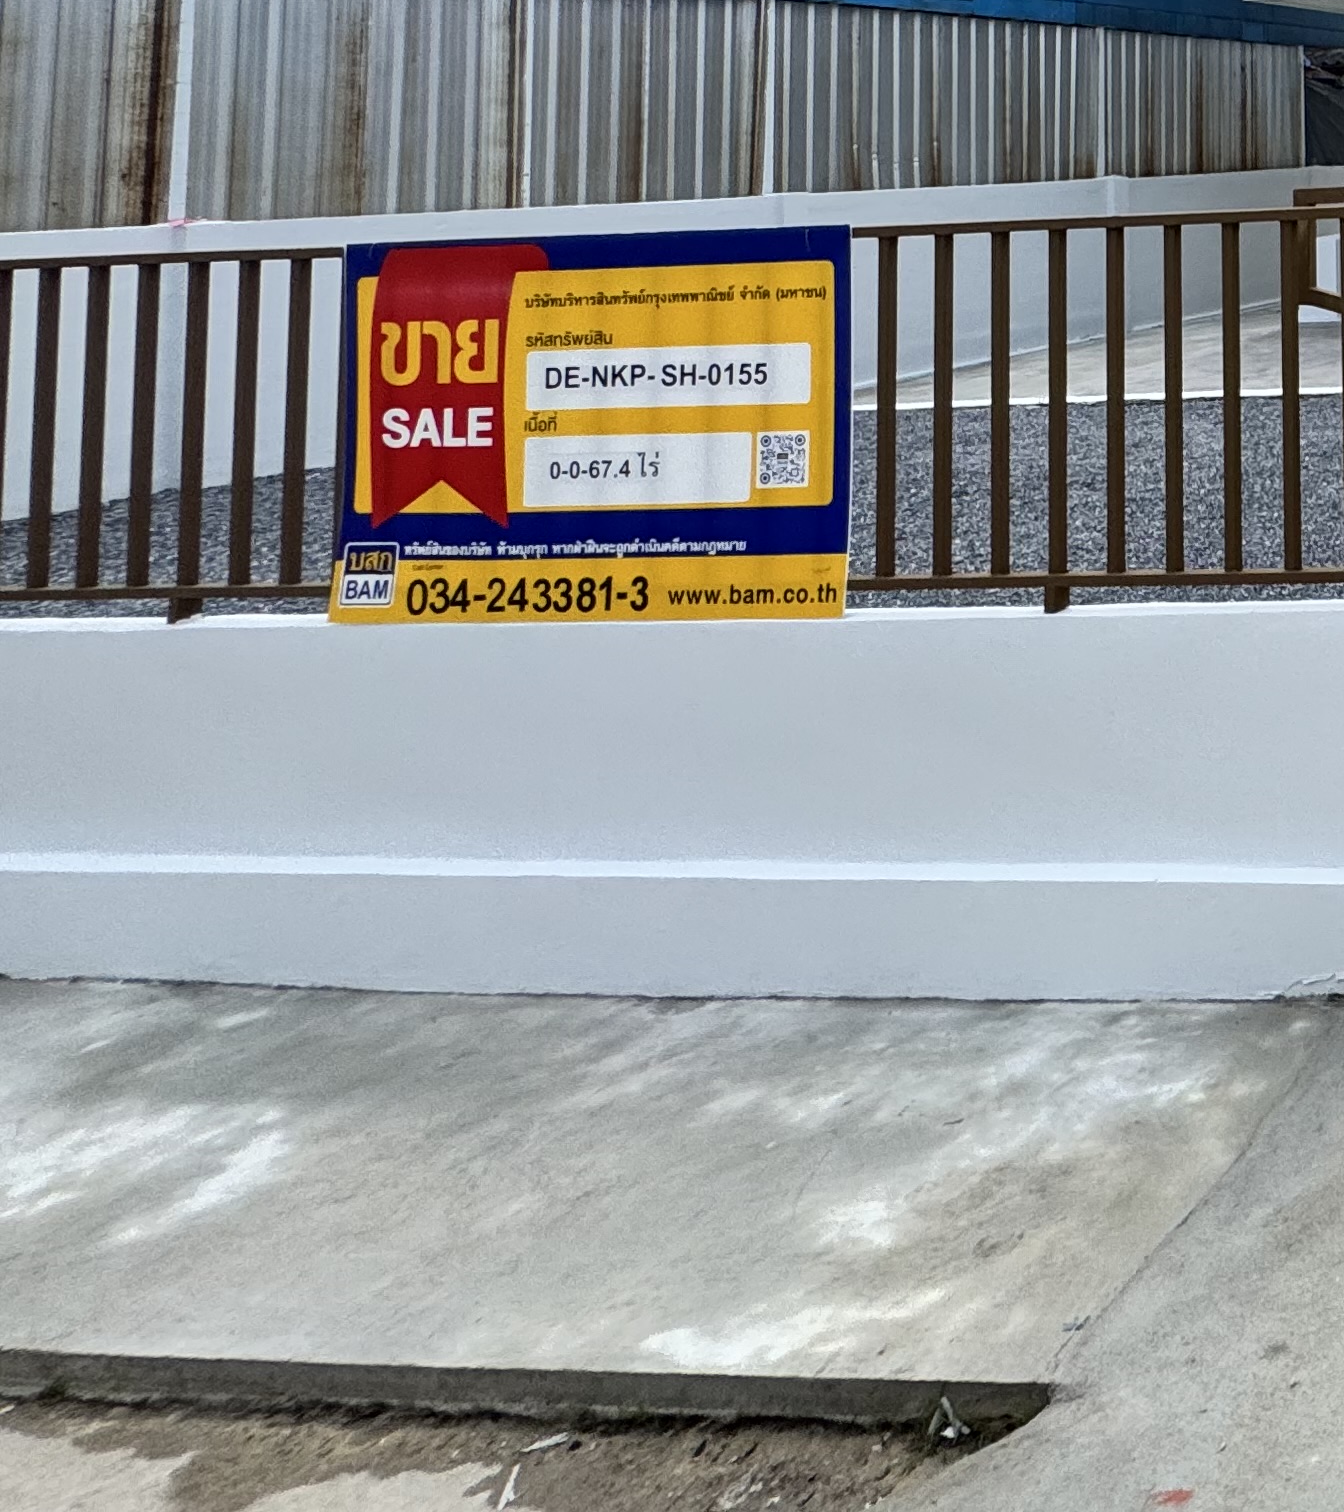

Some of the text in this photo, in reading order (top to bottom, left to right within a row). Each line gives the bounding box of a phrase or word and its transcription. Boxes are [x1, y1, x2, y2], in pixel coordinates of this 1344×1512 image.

[740, 285, 771, 301] จำกัด
[776, 285, 827, 302] (มหาชน)
[525, 330, 614, 347] รหัสทรัพย์สิน
[380, 318, 500, 386] ขาย
[382, 407, 494, 448] SALE
[524, 410, 557, 432] เนื้อที่
[549, 451, 660, 479] 0-0-67.4 ไร่
[349, 550, 393, 572] บสก
[344, 579, 390, 600] BAM
[406, 575, 838, 616] 034-243381-3 www.bam.co.th
